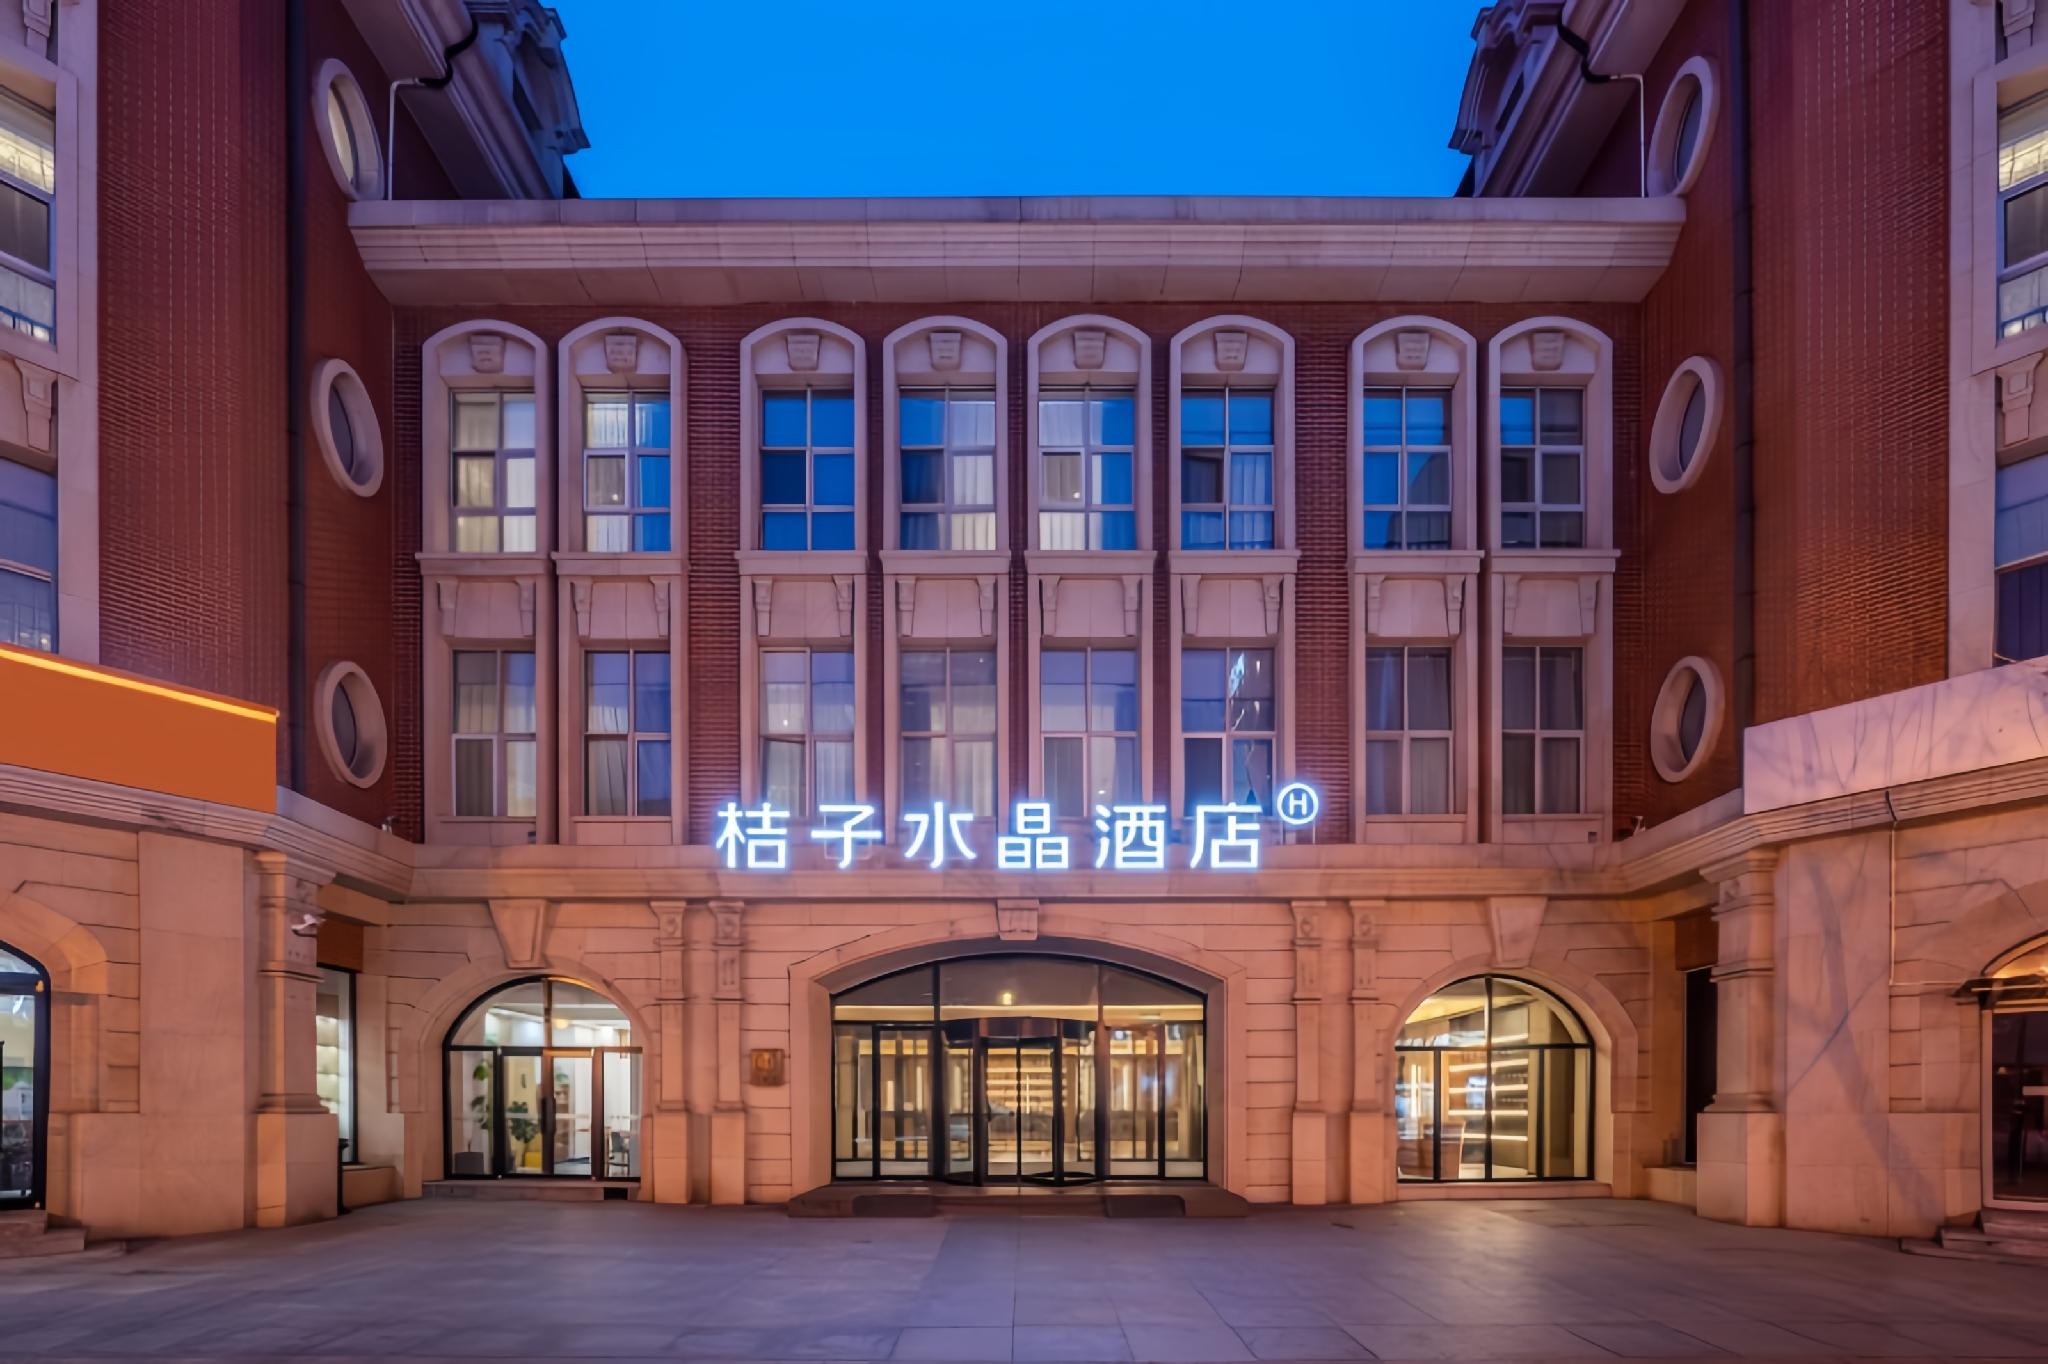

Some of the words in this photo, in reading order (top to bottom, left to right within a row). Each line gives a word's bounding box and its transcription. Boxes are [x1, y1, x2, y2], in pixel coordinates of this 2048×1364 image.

[715, 802, 1262, 869] 桔子水晶酒店
